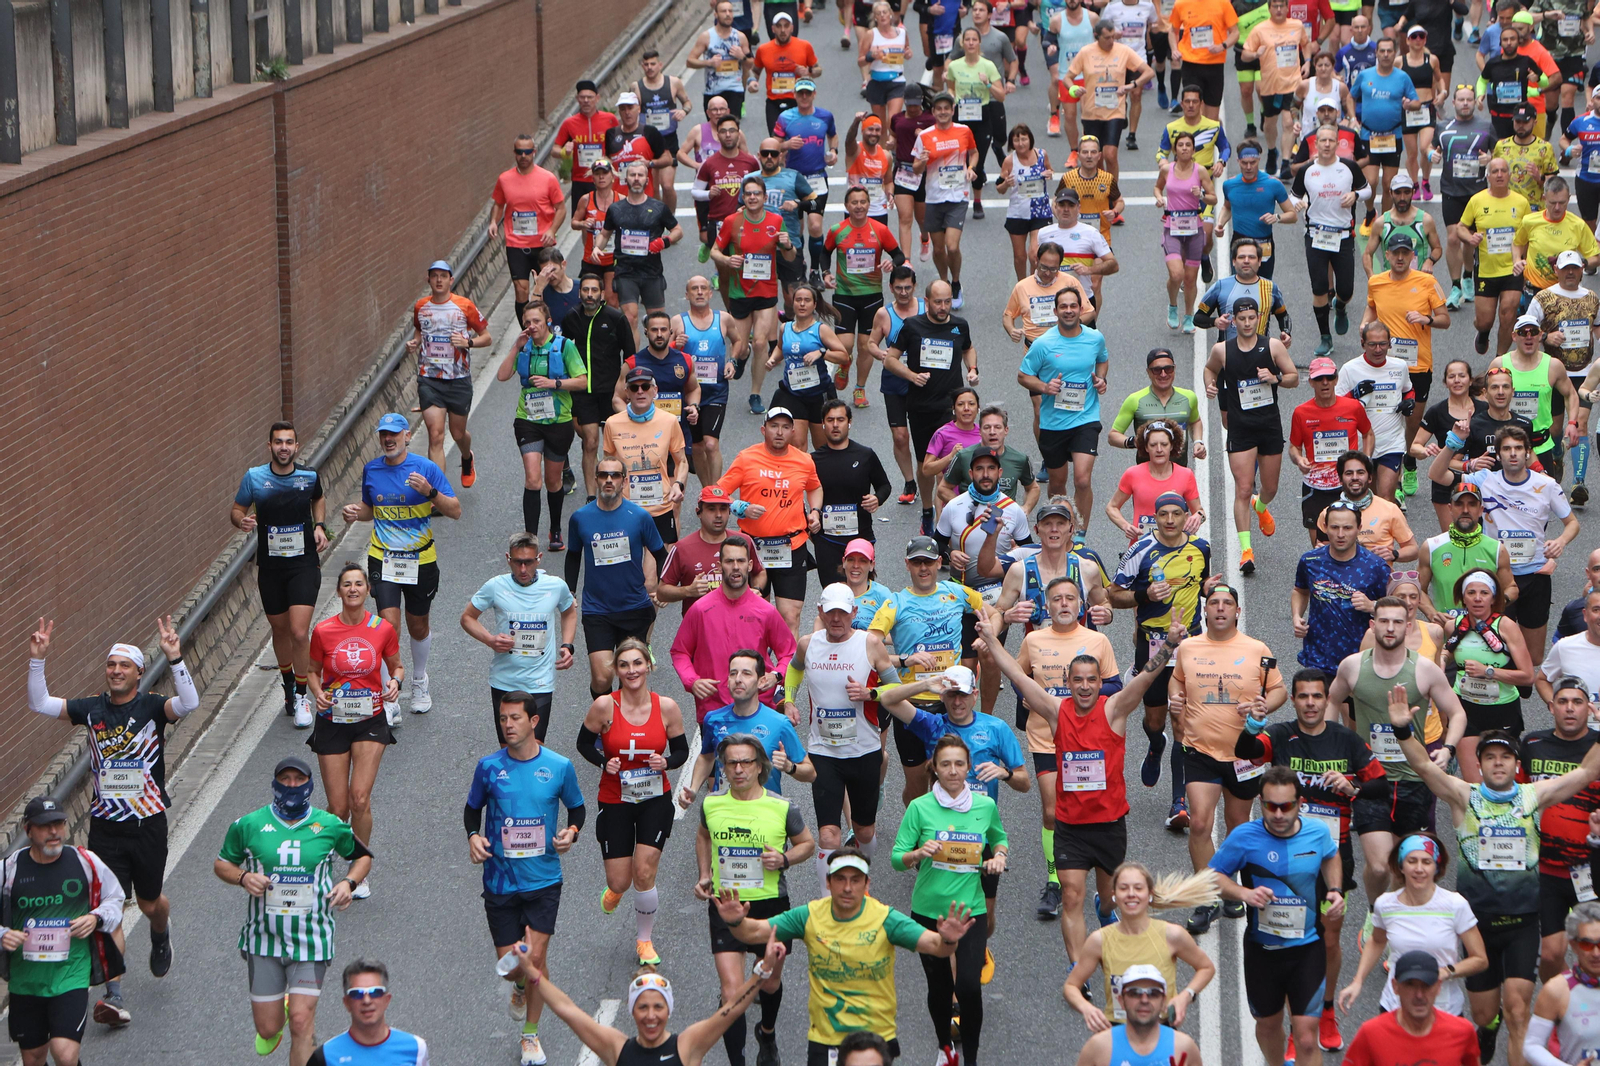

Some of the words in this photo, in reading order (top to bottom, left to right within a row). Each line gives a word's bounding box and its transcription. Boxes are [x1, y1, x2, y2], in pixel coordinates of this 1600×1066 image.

[577, 134, 606, 143] NILS
[1576, 443, 1588, 476] Kalenji
[759, 470, 782, 480] NEV
[639, 477, 656, 485] ZURICH
[774, 480, 789, 488] ER
[760, 488, 786, 499] GIVE
[780, 500, 794, 508] UP
[374, 506, 414, 520] OSSET
[603, 532, 624, 540] ZURICH
[602, 544, 619, 552] 10474
[978, 583, 998, 592] ZURICH
[927, 643, 950, 651] ZURICH
[812, 662, 855, 670] DANMARK
[1470, 682, 1487, 690] 10372
[828, 708, 852, 718] ZURICH
[1304, 760, 1348, 773] RUNNING
[634, 780, 651, 788] 10318
[1312, 806, 1336, 815] ZURICH
[276, 840, 300, 866] fi
[18, 893, 64, 909] Orona
[38, 919, 66, 927] ZURICH
[38, 933, 54, 941] 7311
